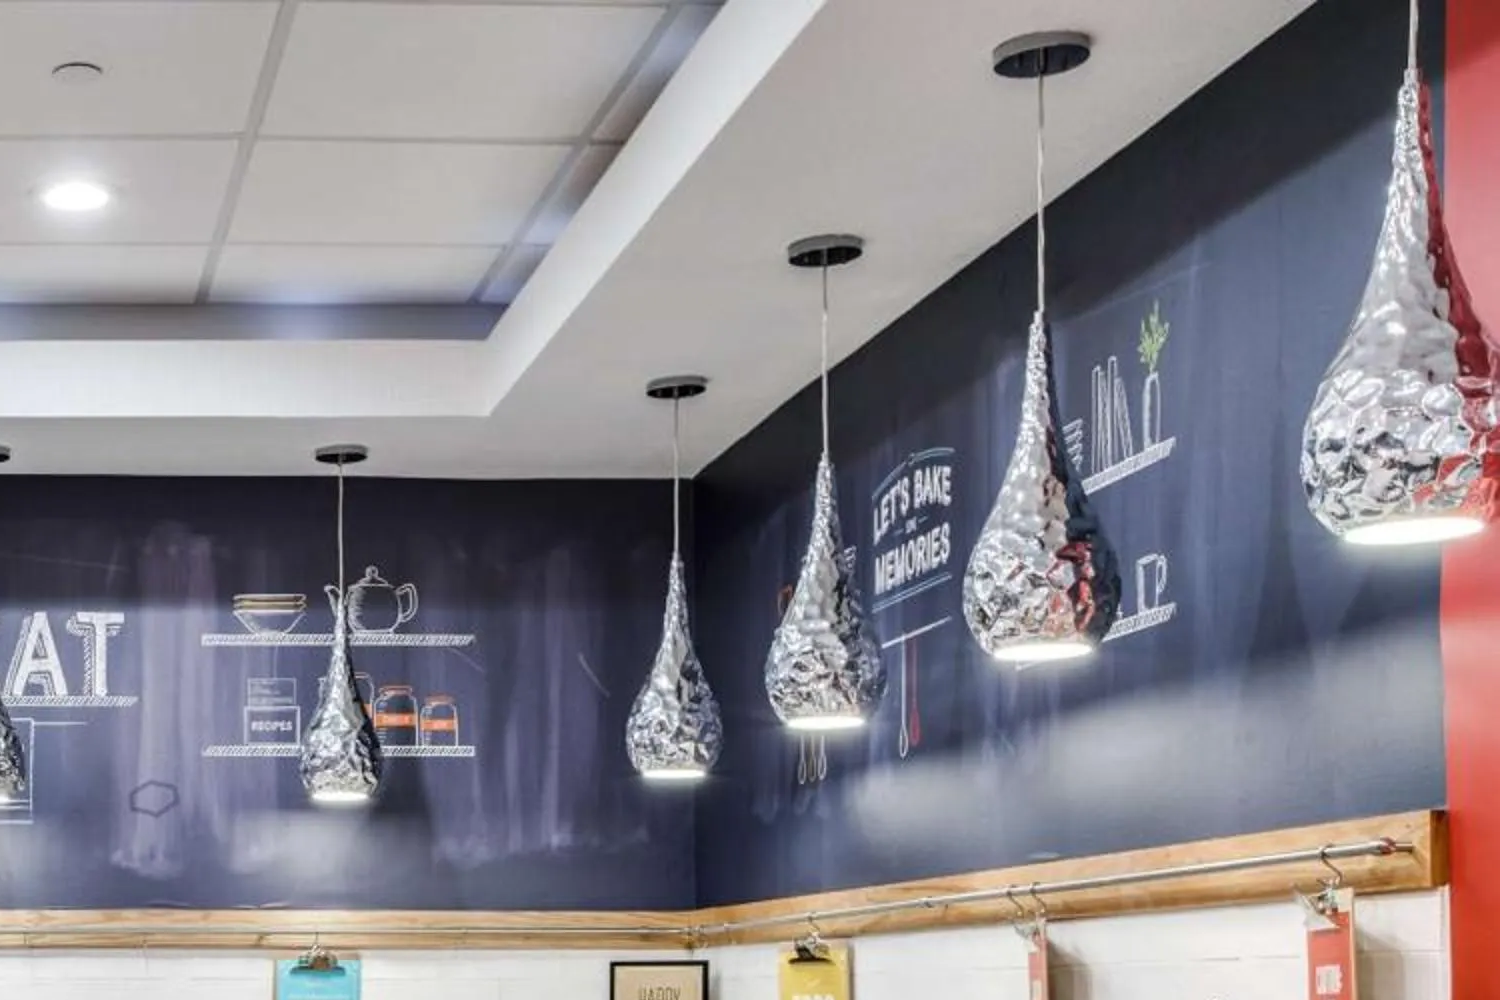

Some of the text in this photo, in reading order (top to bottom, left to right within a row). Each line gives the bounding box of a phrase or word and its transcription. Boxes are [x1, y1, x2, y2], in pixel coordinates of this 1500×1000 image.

[873, 465, 952, 546] LET'S BAKE
[874, 522, 951, 596] MEMORIES
[251, 720, 293, 731] RECIPES
